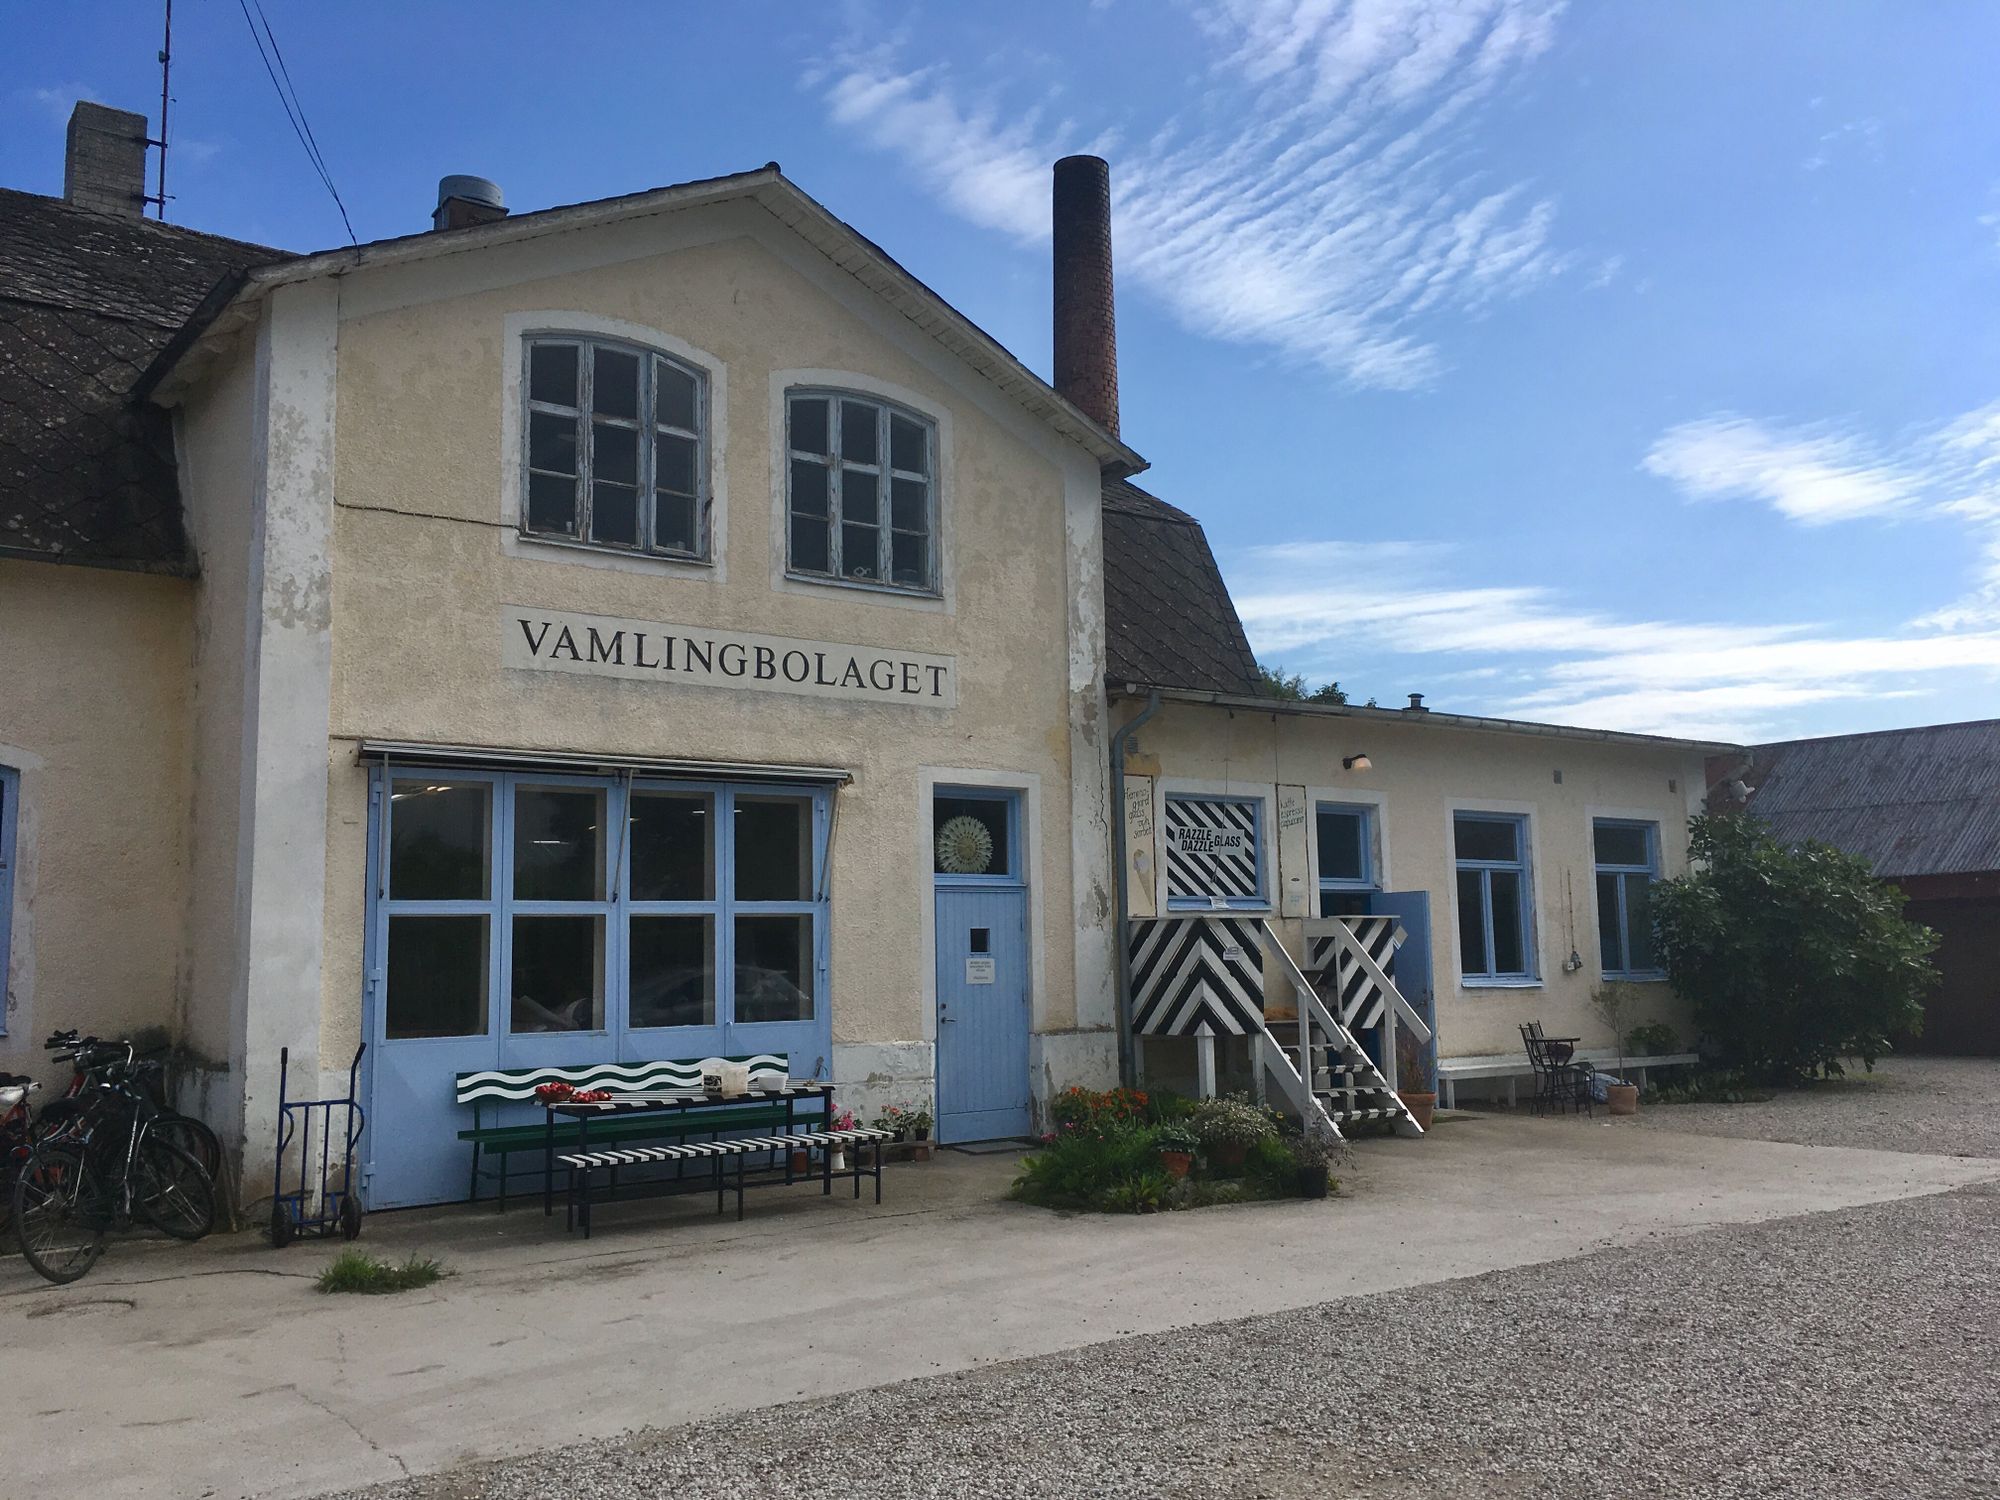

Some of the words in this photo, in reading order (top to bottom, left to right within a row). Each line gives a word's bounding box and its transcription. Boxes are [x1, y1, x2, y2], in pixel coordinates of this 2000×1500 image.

[517, 618, 947, 697] VAMLINGBOLAGET
[1178, 828, 1212, 841] RAZZLE
[1181, 840, 1214, 852] DAZZLE
[1214, 835, 1241, 847] GLASS
